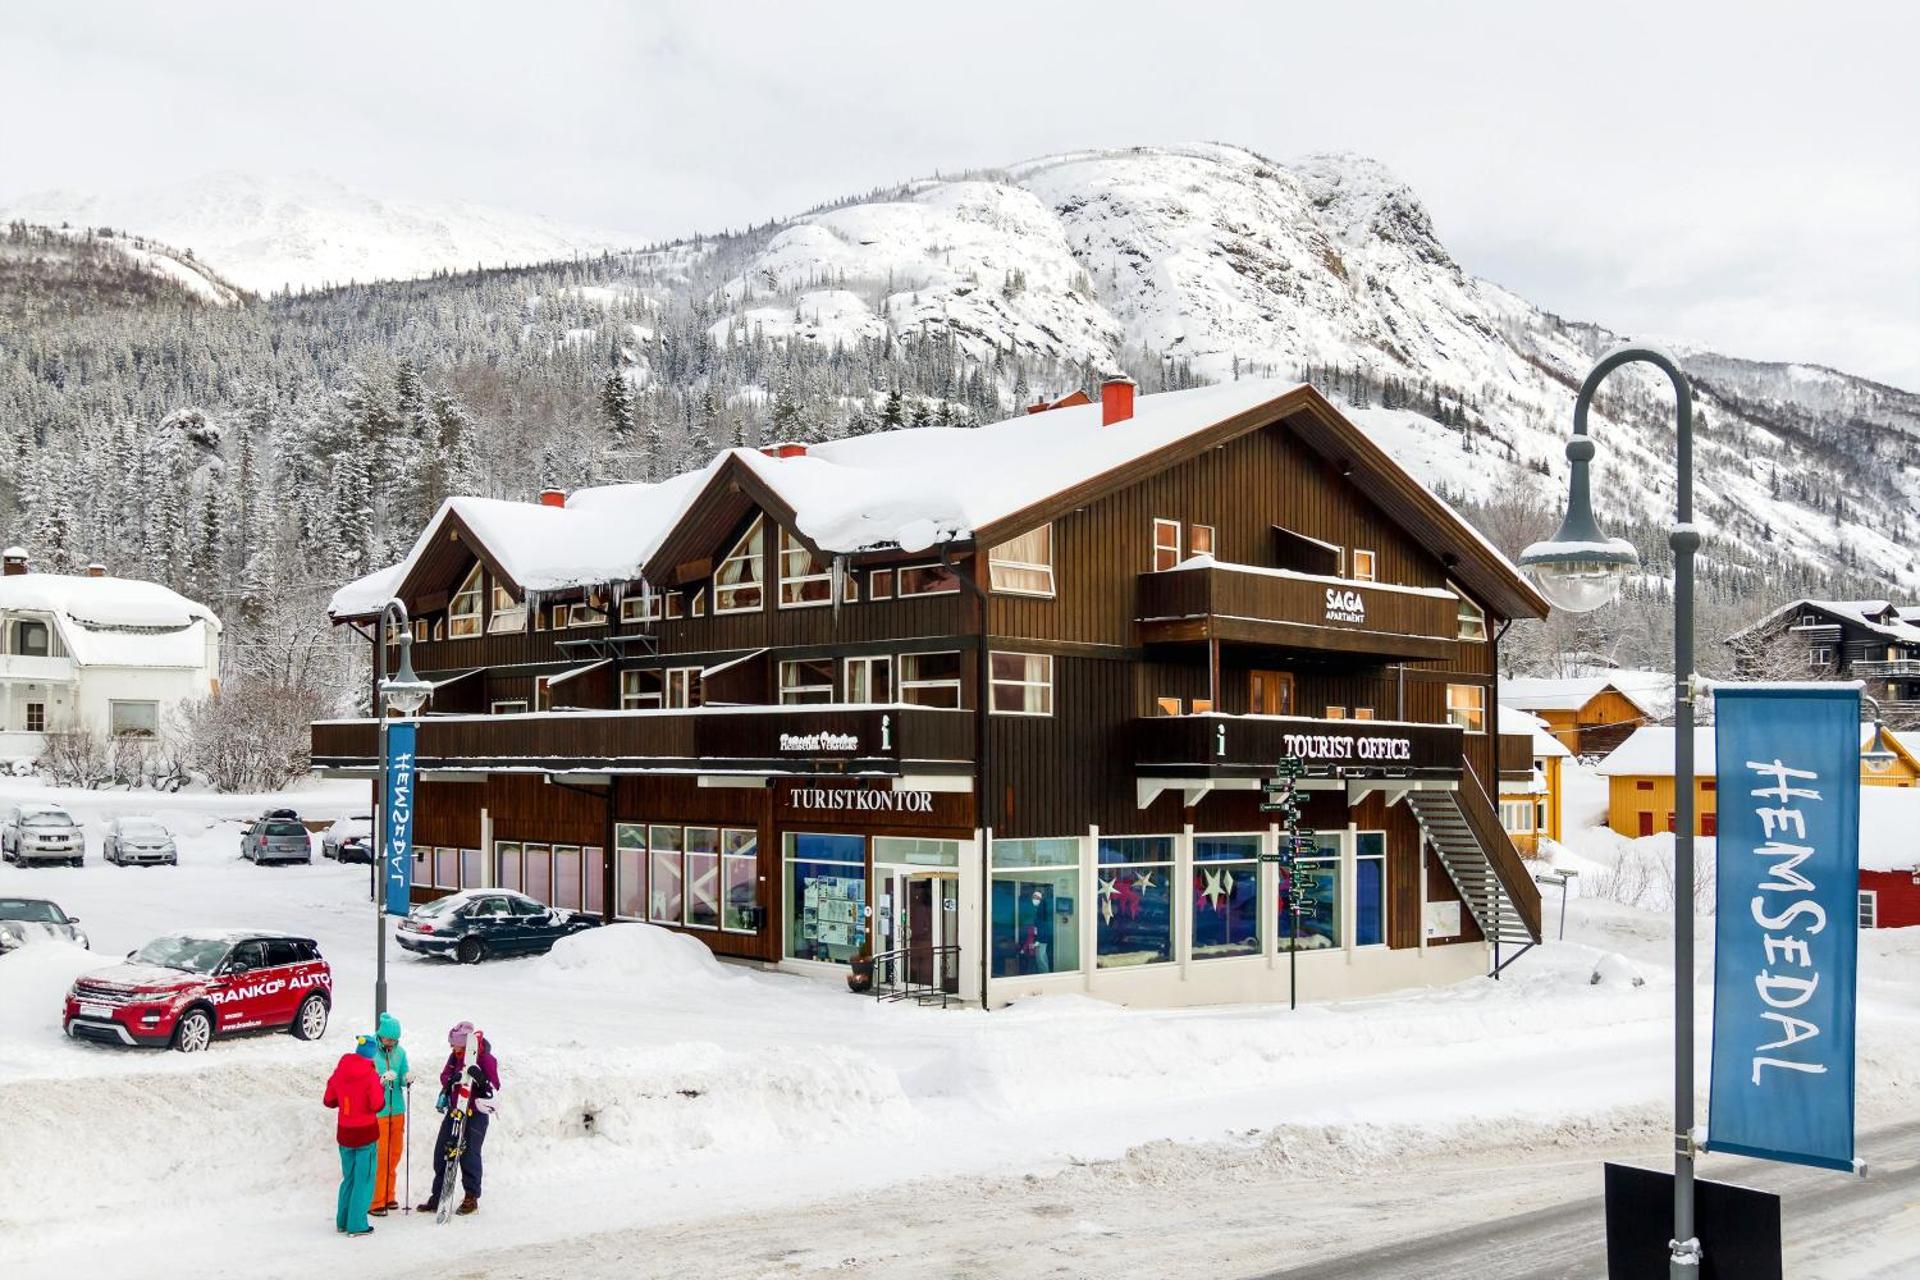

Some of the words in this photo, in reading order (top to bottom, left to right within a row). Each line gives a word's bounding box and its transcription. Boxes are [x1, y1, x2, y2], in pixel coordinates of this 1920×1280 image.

[1326, 588, 1365, 612] SAGA
[1325, 610, 1365, 623] APARTMENT
[1283, 734, 1354, 759] TOURIST
[1357, 735, 1411, 760] OFFICE
[790, 788, 933, 812] TURISTKONTOR
[1745, 758, 1827, 1087] HEMSEDAL
[289, 972, 330, 991] AUTO
